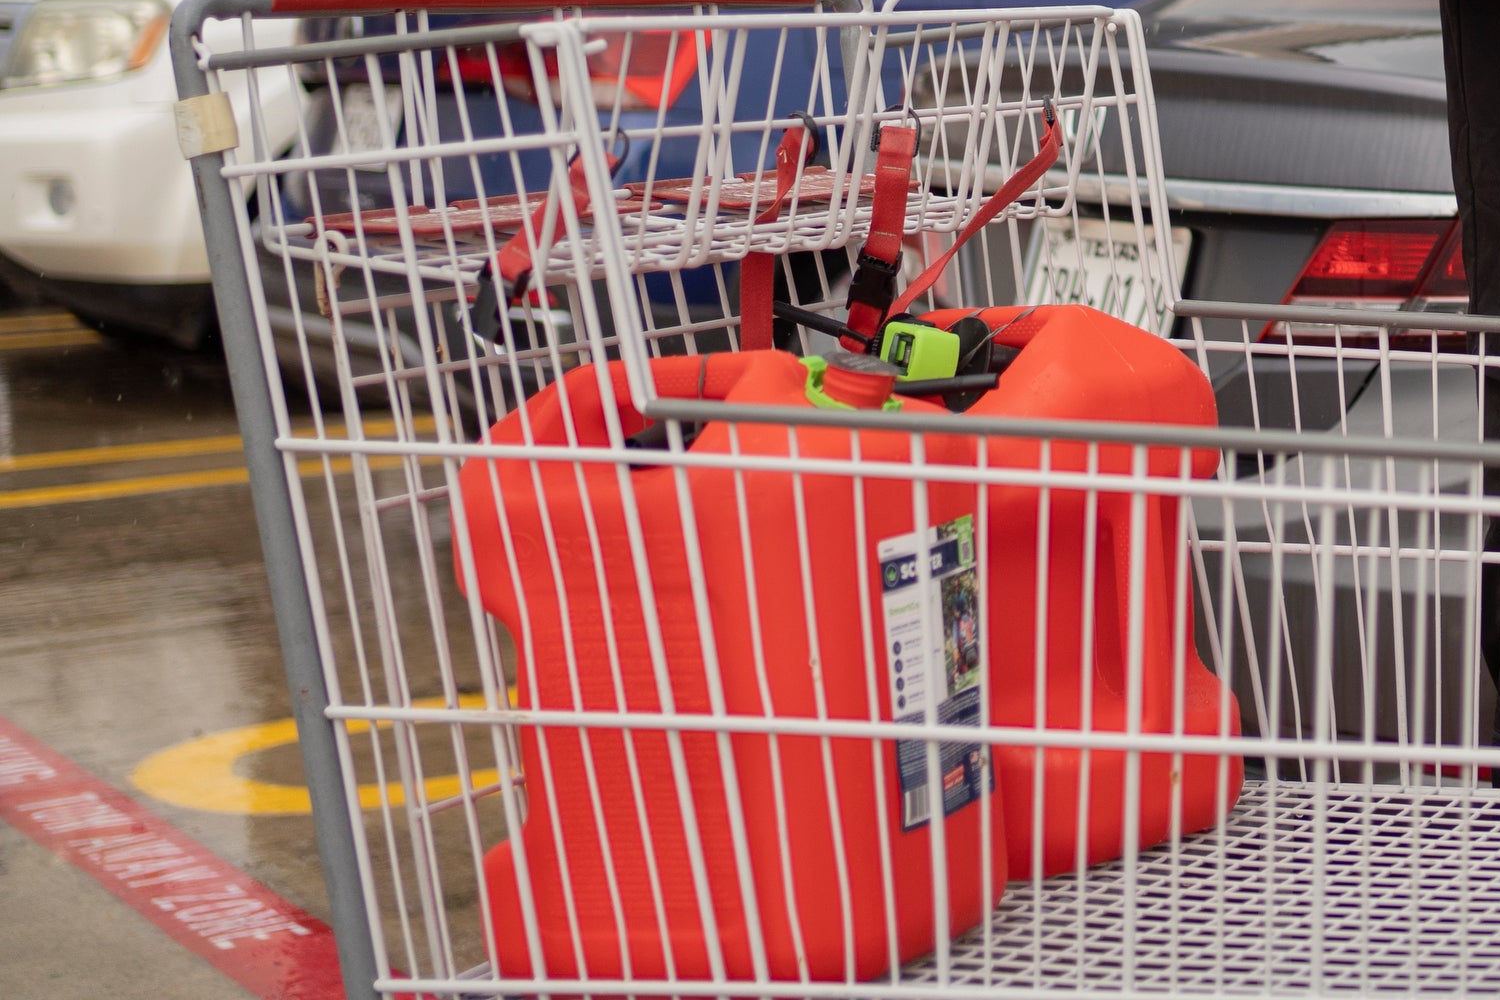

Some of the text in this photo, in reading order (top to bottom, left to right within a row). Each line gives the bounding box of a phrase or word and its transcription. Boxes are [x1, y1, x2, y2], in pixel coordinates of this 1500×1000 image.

[1085, 239, 1139, 262] TEXAS
[66, 831, 221, 889] AWAY
[152, 883, 312, 950] ZONE
